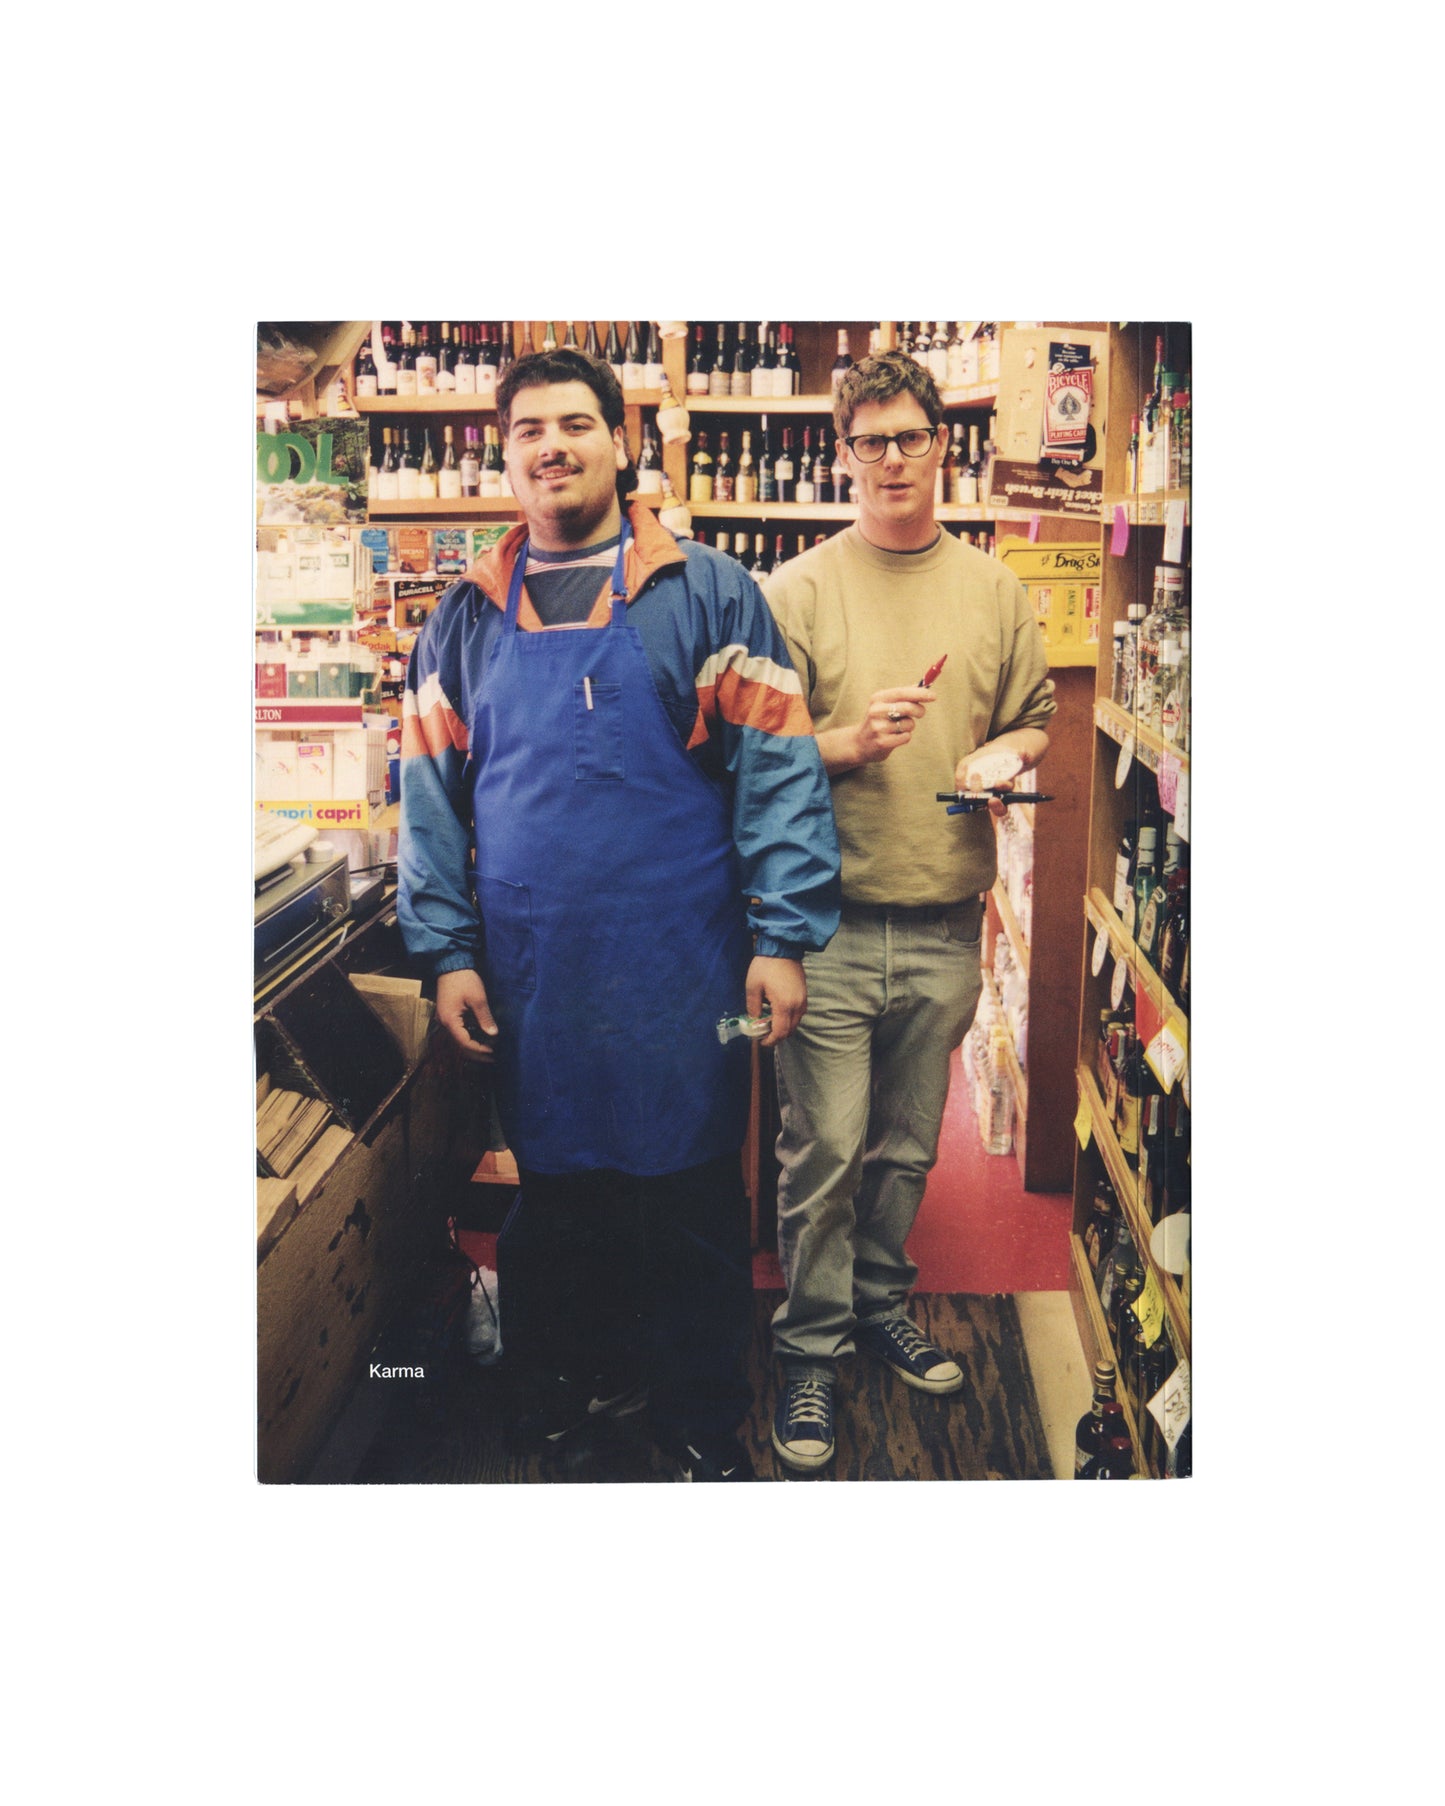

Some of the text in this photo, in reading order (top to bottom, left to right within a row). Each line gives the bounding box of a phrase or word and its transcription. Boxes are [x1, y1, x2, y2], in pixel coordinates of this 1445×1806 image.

[1049, 373, 1089, 394] BICYCLE
[1054, 553, 1085, 571] Drug
[398, 586, 435, 598] DURACELL
[361, 640, 391, 651] Kodak
[270, 804, 361, 823] apri capri
